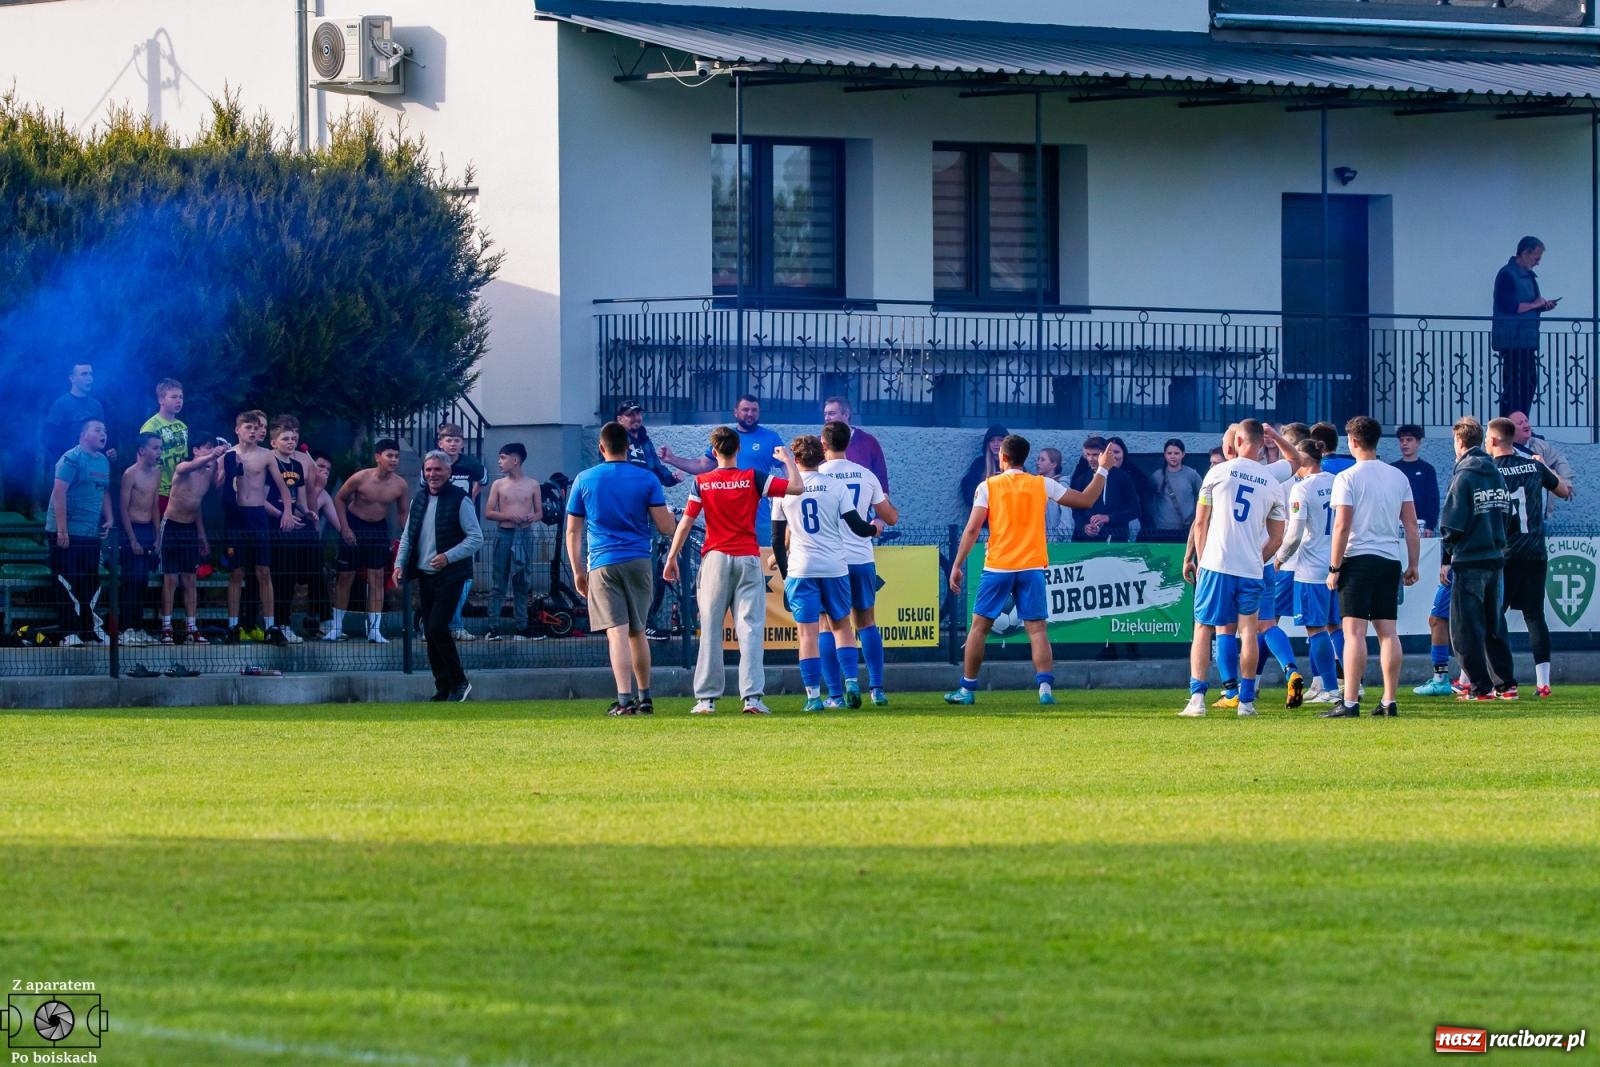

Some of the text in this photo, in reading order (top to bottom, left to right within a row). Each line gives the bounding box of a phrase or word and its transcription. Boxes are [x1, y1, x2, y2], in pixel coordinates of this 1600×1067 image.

[700, 480, 750, 491] KS KOLEJARZ
[847, 484, 861, 509] 7
[1233, 484, 1255, 522] 5
[801, 498, 820, 534] 8
[1051, 580, 1147, 614] DROBNY
[898, 607, 935, 622] USŁUGI
[1111, 618, 1181, 637] Dziękujemy
